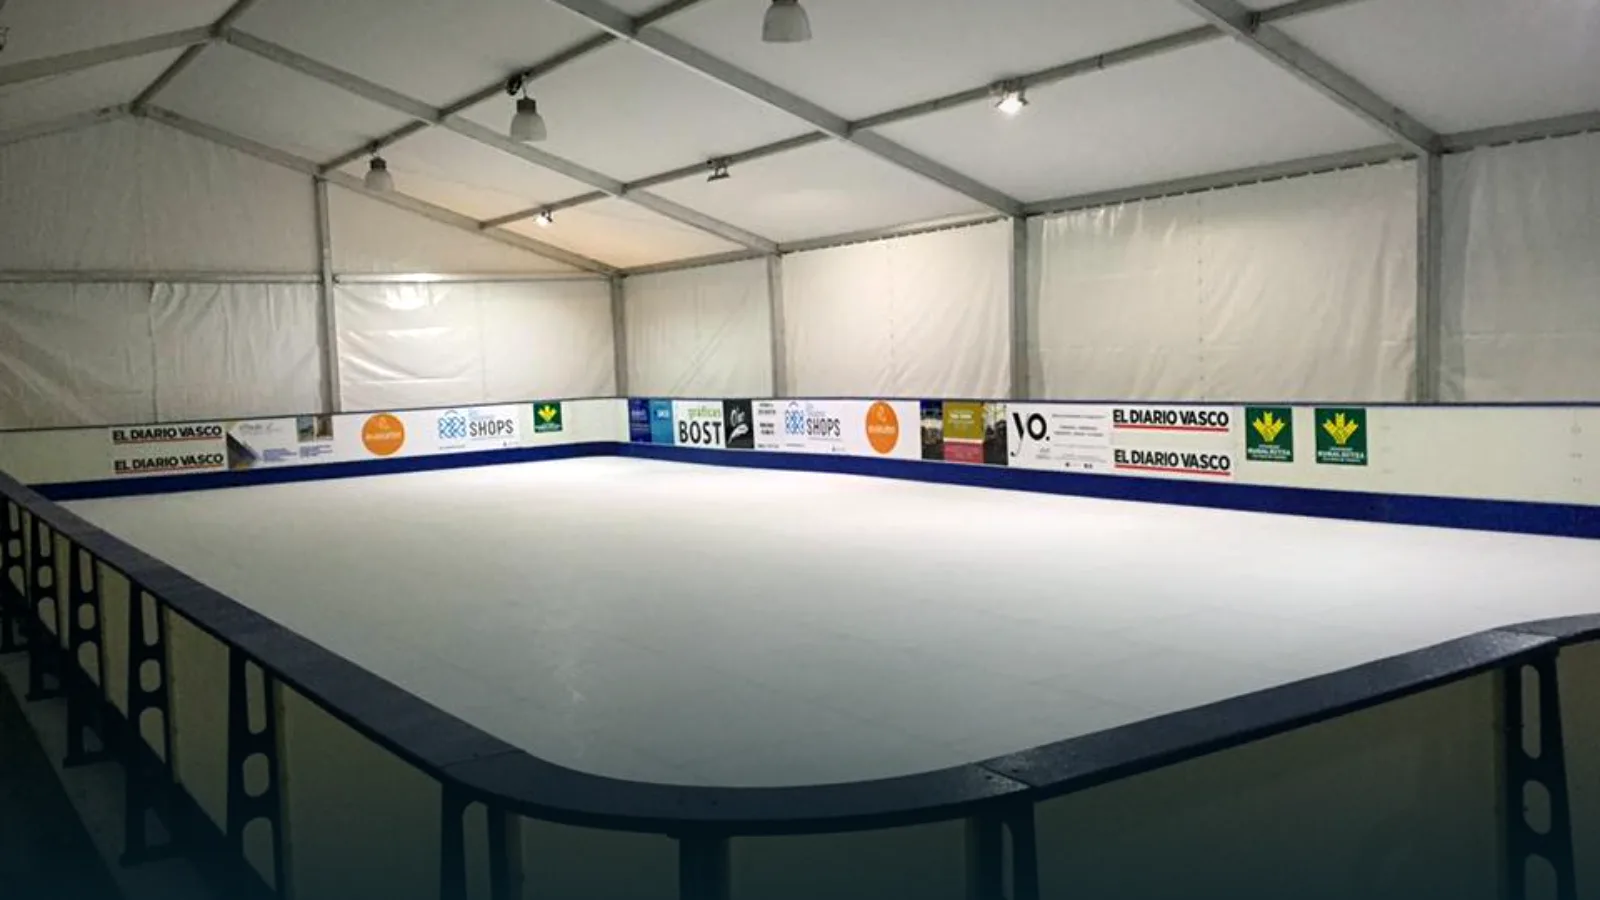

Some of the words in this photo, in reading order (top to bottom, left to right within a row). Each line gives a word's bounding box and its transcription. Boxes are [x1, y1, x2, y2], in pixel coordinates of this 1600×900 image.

[469, 418, 514, 437] SHOPS
[805, 418, 841, 437] SHOPS
[1112, 409, 1128, 423] EL
[1129, 409, 1178, 425] DIARIO
[1179, 410, 1229, 427] VASCO
[112, 429, 130, 441] EL
[130, 427, 176, 440] DIARIO
[177, 425, 223, 438] VASCO
[678, 420, 722, 445] BOST
[114, 459, 130, 471] EL
[132, 456, 178, 469] DIARIO
[180, 453, 224, 466] VASCO
[1114, 448, 1129, 463] EL
[1130, 450, 1179, 467] DIARIO
[1180, 453, 1231, 471] VASCO
